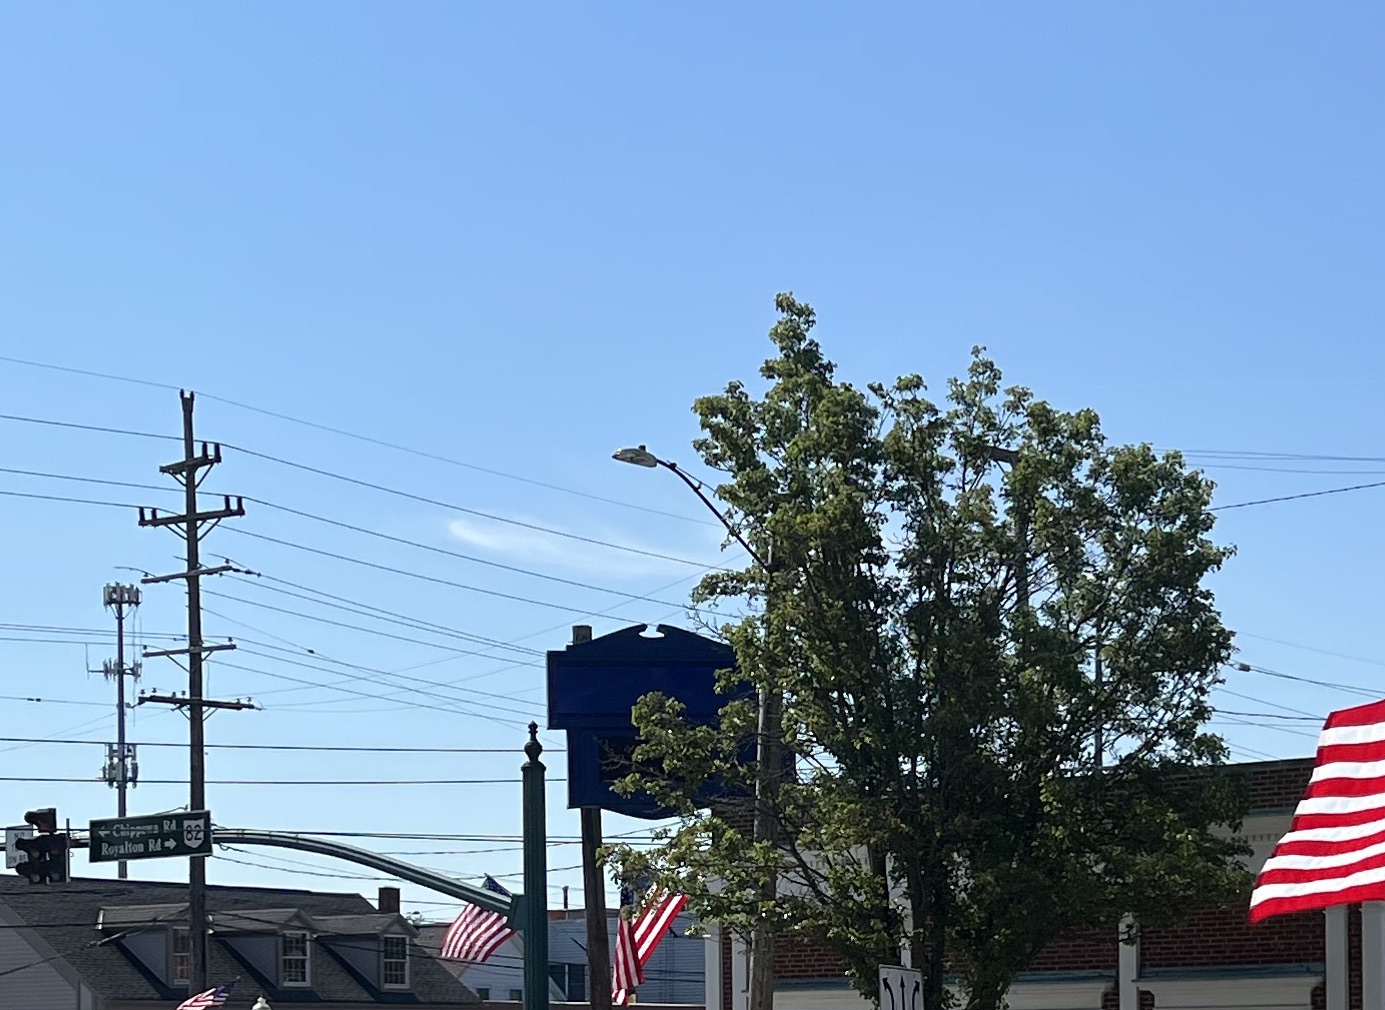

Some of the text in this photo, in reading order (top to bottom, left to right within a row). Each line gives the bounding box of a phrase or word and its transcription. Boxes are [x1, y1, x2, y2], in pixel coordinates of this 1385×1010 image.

[163, 819, 177, 833] Rd
[186, 824, 202, 841] 82
[101, 838, 162, 857] Royalton Rd
